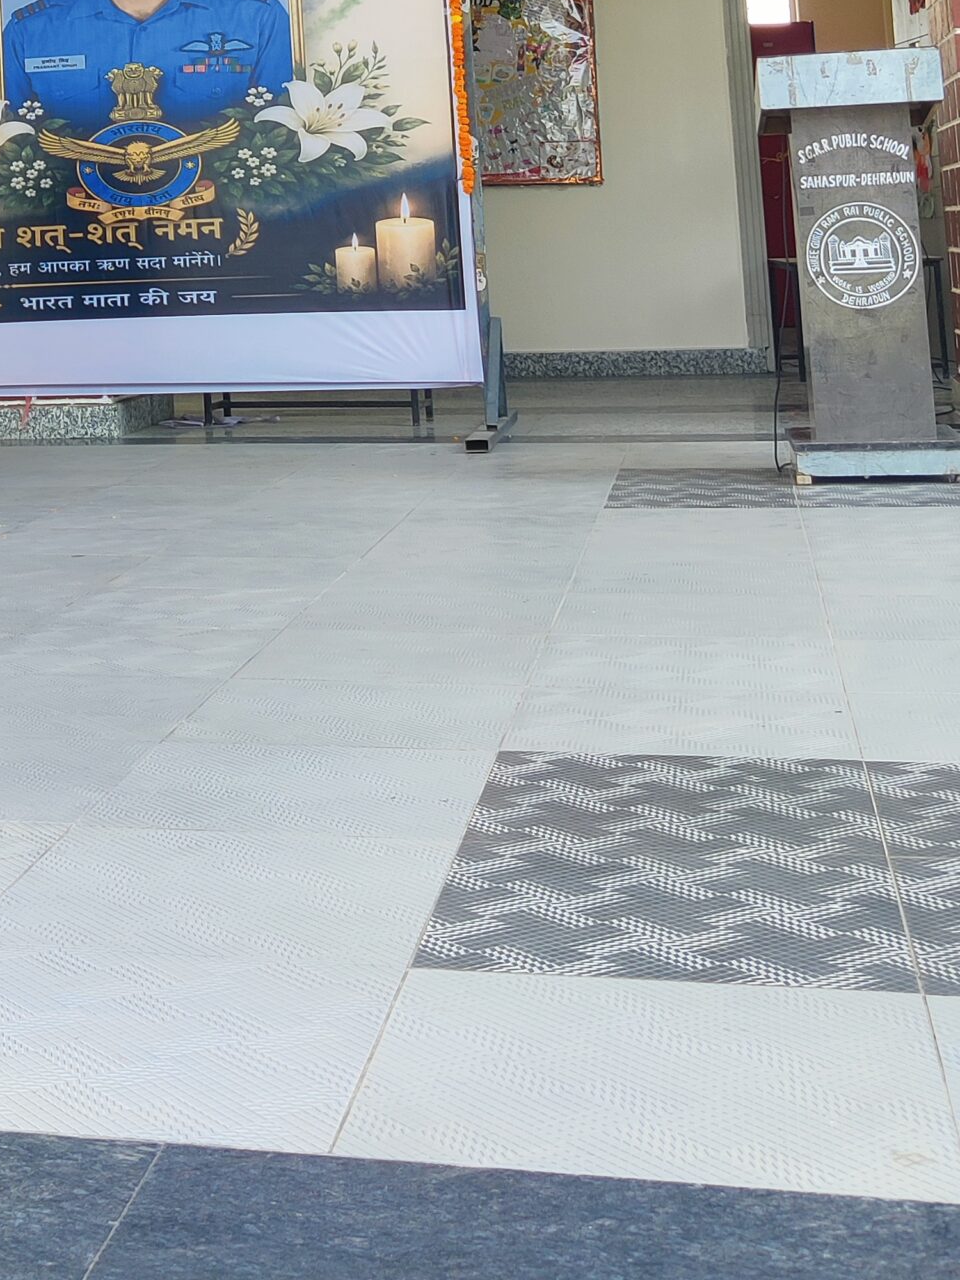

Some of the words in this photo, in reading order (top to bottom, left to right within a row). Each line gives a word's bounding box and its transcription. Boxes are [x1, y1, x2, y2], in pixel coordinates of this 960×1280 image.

[831, 133, 868, 150] PUBLIC
[869, 134, 910, 160] SCHOOL
[152, 218, 224, 241] नमन
[821, 212, 840, 229] RAM
[843, 206, 859, 217] RAI
[863, 206, 894, 227] PUBLIC
[895, 227, 914, 269] SCHOOL
[8, 262, 32, 277] हम
[38, 260, 90, 273] आपका
[96, 258, 130, 271] ऋण
[136, 257, 167, 270] सदा
[19, 296, 74, 310] भारत
[81, 294, 131, 308] माता
[138, 288, 170, 305] की
[177, 290, 218, 304] जय
[841, 291, 891, 306] DEHRADUN
